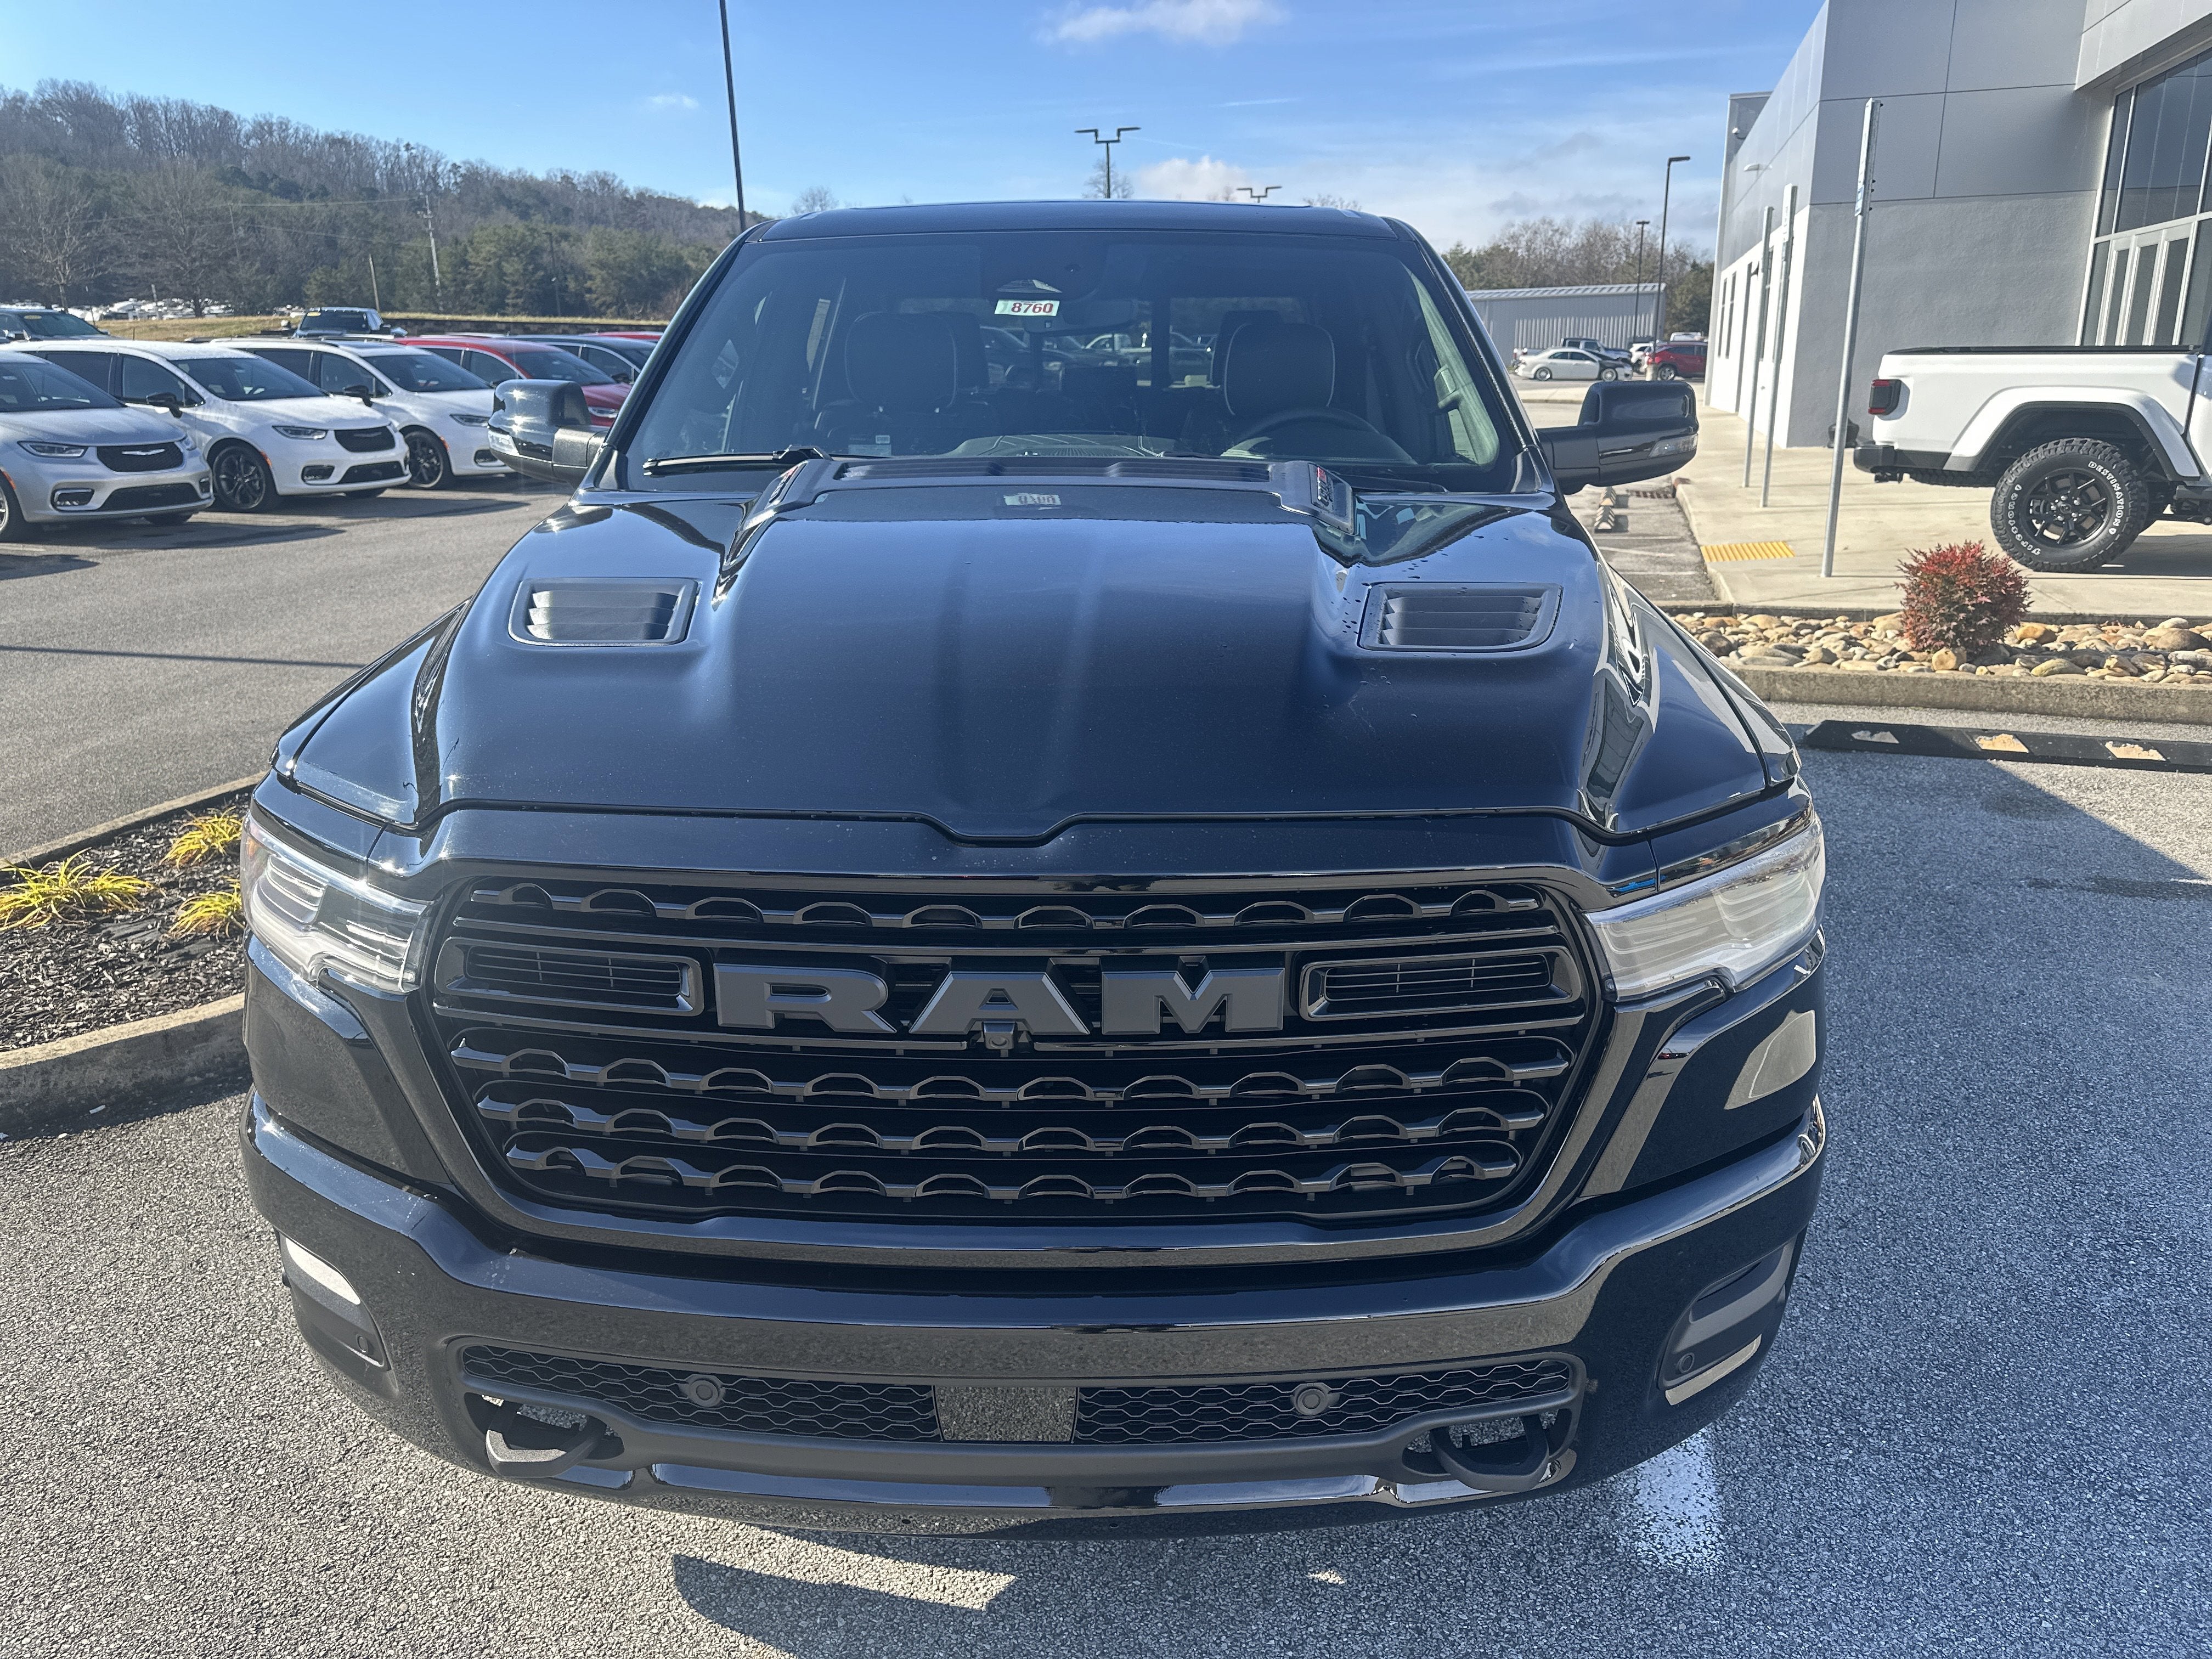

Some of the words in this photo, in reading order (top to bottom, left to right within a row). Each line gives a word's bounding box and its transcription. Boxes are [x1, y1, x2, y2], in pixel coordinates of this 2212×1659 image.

[1011, 302, 1053, 313] 8760
[2088, 461, 2124, 527] DESTINATION
[714, 963, 1285, 1036] RAM
